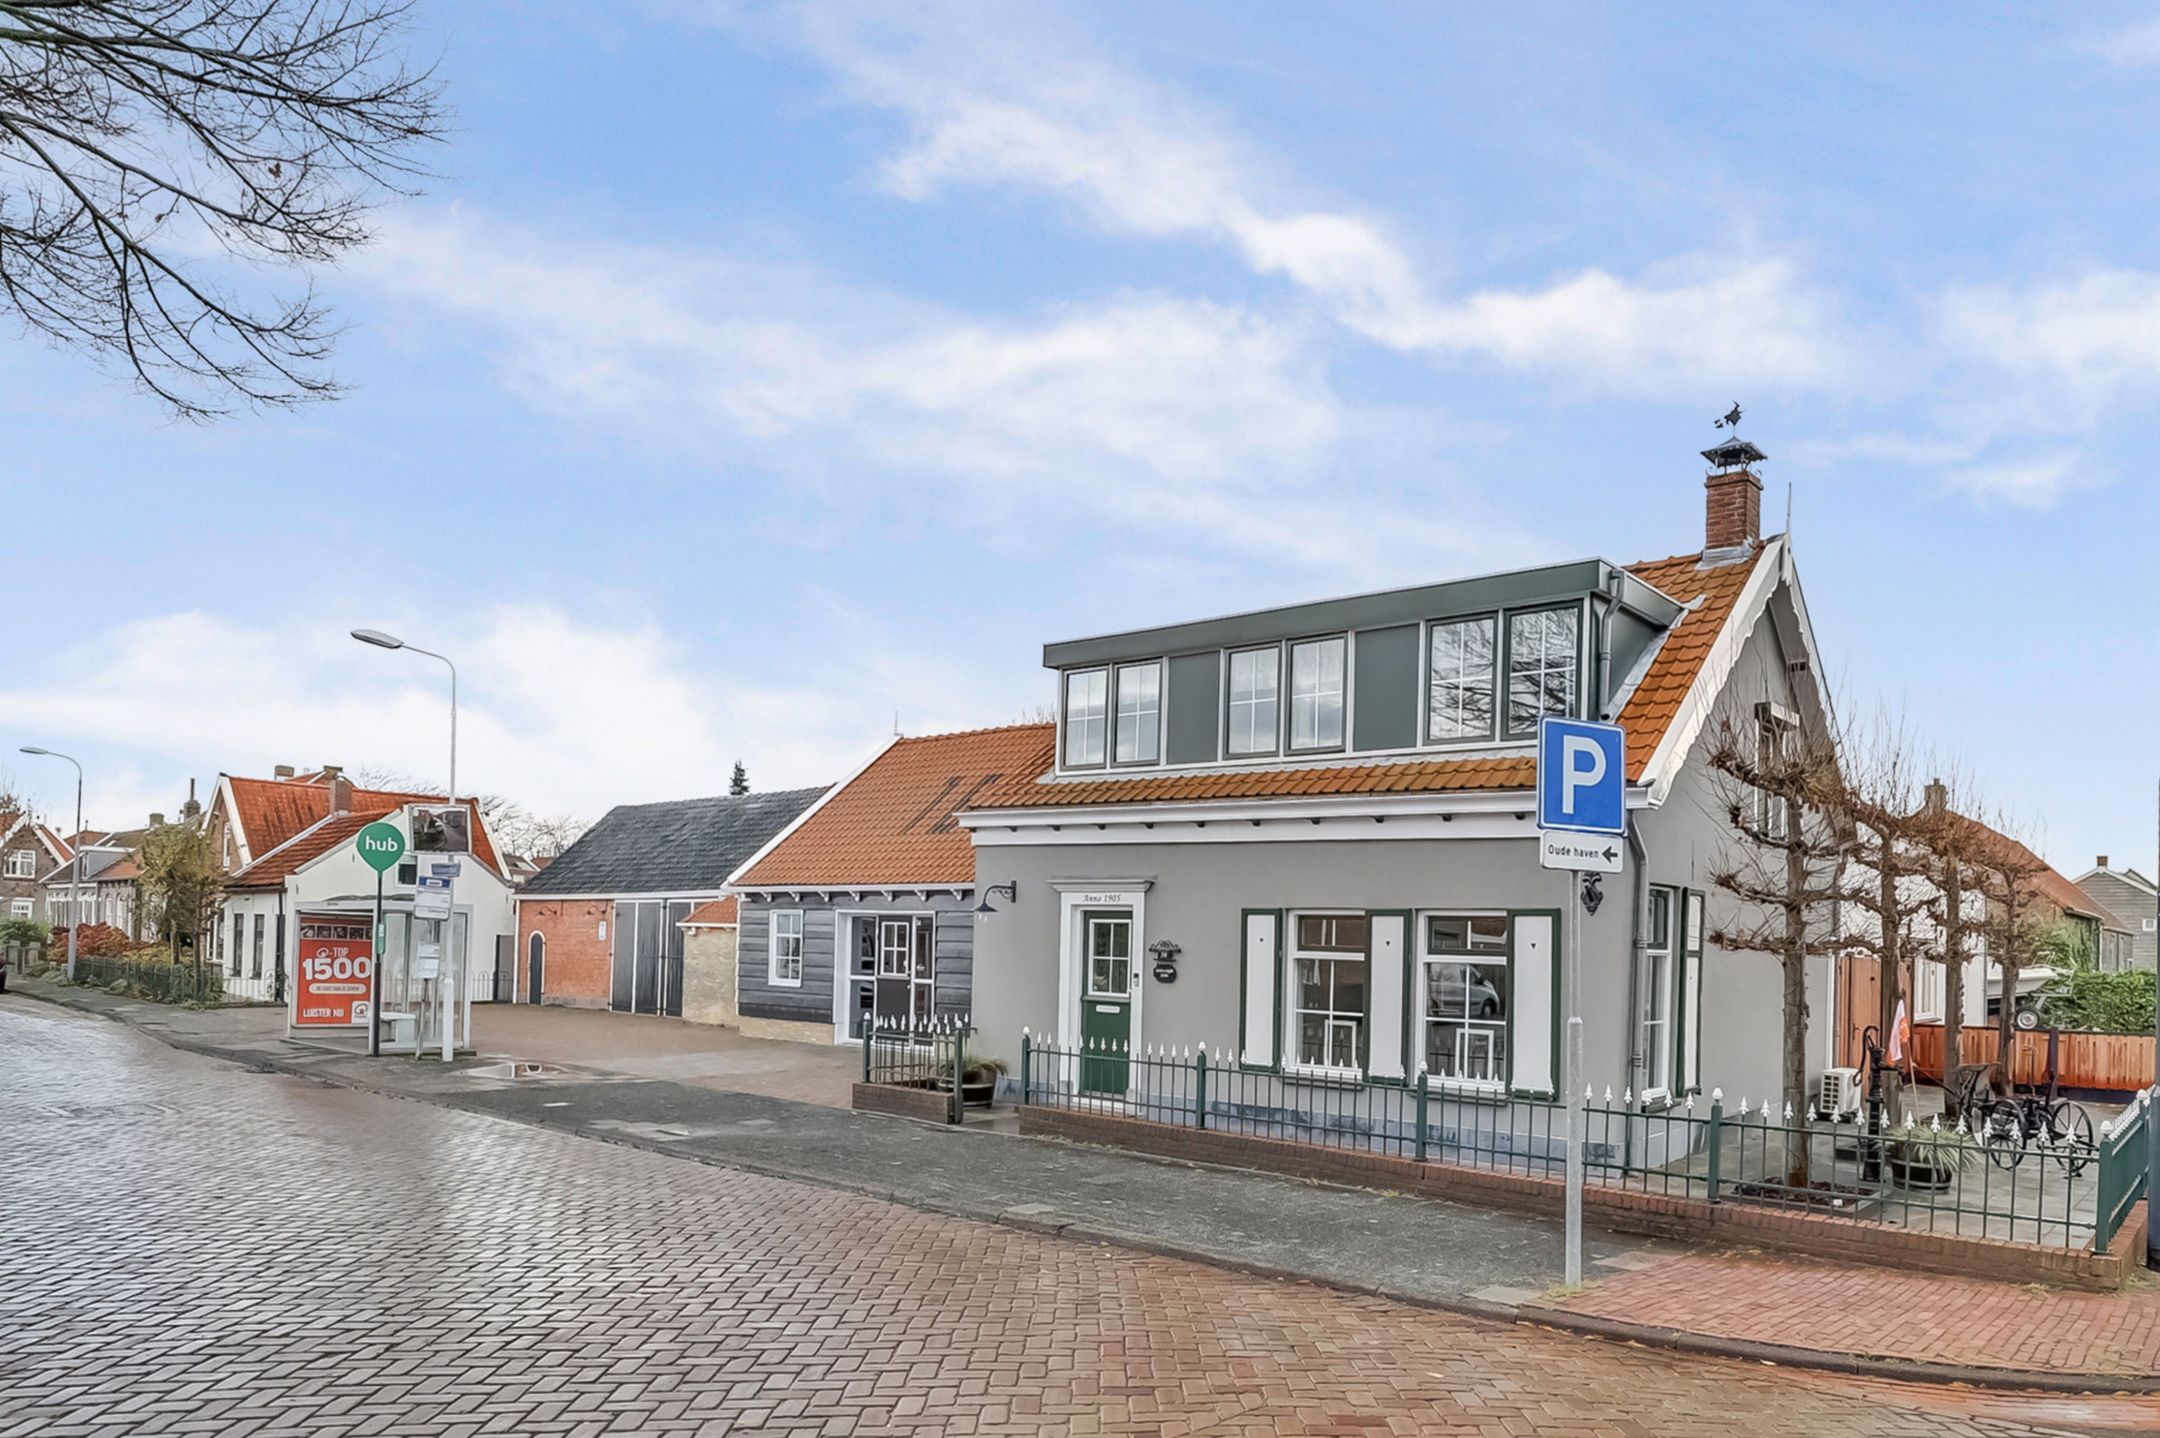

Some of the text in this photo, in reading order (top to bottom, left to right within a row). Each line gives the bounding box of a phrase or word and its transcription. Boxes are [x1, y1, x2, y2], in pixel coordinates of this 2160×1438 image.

[1562, 734, 1607, 814] P
[365, 835, 398, 852] hub
[1548, 844, 1599, 859] Oude haven
[1103, 893, 1122, 903] 1905
[302, 956, 372, 980] 1500
[303, 1007, 332, 1017] LUISTER
[332, 1008, 345, 1017] NU
